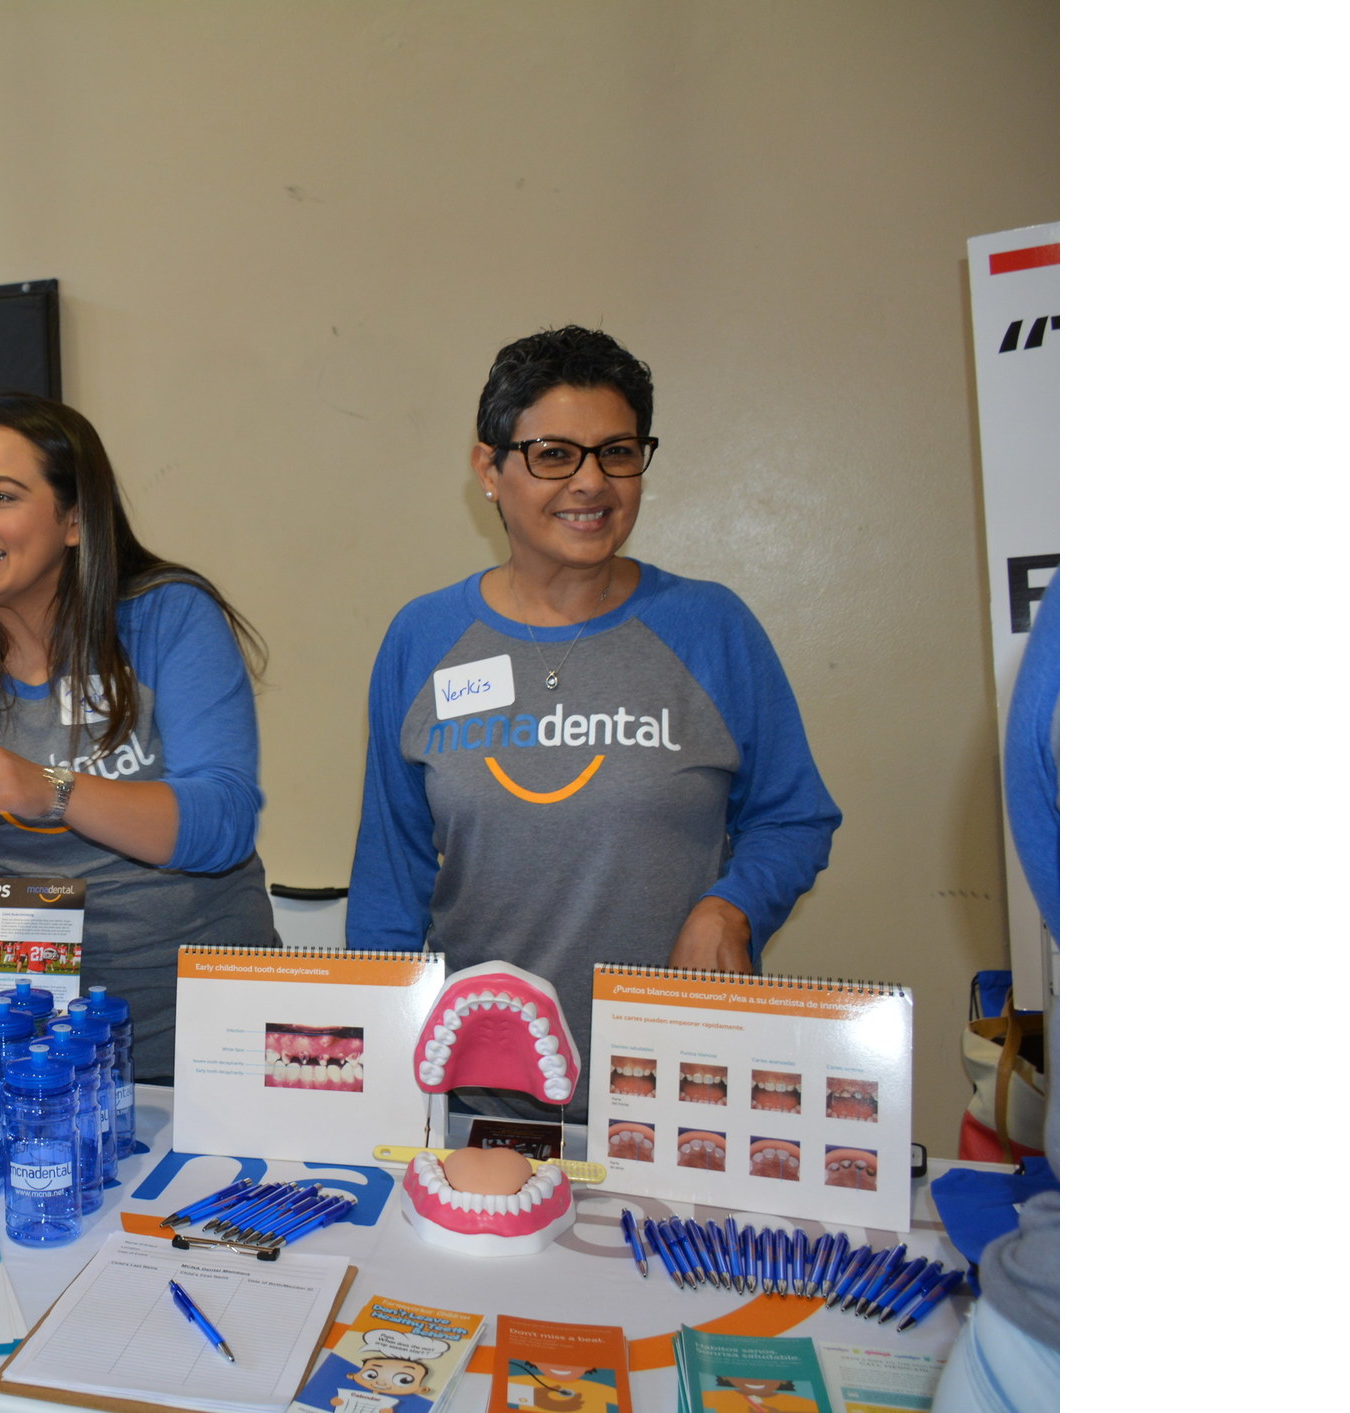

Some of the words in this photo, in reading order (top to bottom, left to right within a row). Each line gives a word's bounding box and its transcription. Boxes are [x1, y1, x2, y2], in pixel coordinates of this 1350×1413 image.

[441, 679, 491, 702] Verkis
[423, 703, 681, 751] mcnadental
[27, 886, 75, 895] mcnadental
[195, 963, 213, 972] Early
[215, 964, 253, 973] childhood
[276, 967, 330, 976] decay/cavities
[613, 985, 645, 994] ¿Puntos
[647, 988, 680, 997] blancos
[689, 991, 726, 1001] oscuros?
[768, 997, 805, 1008] dentista
[644, 1016, 667, 1025] pueden
[669, 1019, 700, 1028] empeorar
[10, 1164, 71, 1179] mcnadental
[372, 1303, 407, 1317] Don't
[409, 1312, 451, 1325] Leave
[371, 1311, 425, 1330] Healthy
[427, 1322, 468, 1335] Teeth
[412, 1328, 461, 1342] Behind
[509, 1328, 538, 1338] Don't
[540, 1332, 566, 1341] miss
[577, 1335, 605, 1344] beat.
